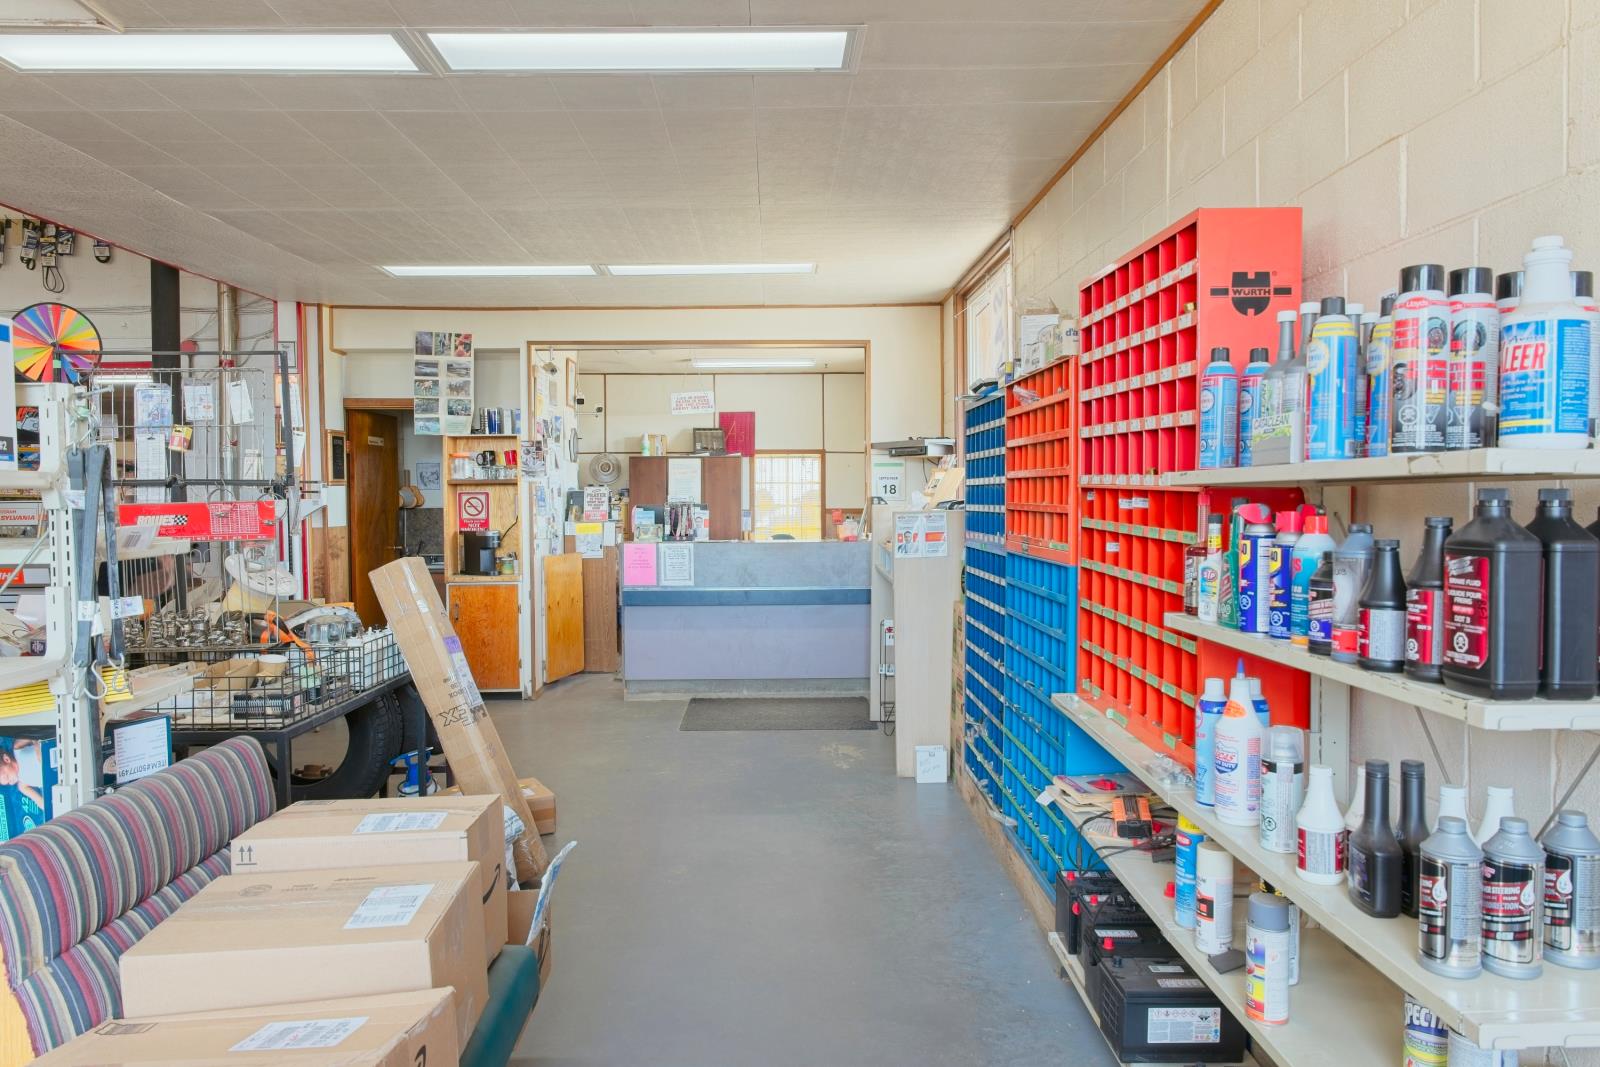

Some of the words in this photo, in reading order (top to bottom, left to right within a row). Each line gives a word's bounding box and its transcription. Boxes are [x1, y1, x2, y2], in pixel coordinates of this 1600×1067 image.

[1500, 341, 1547, 374] LEER
[882, 484, 897, 495] 18
[1202, 569, 1217, 579] STP
